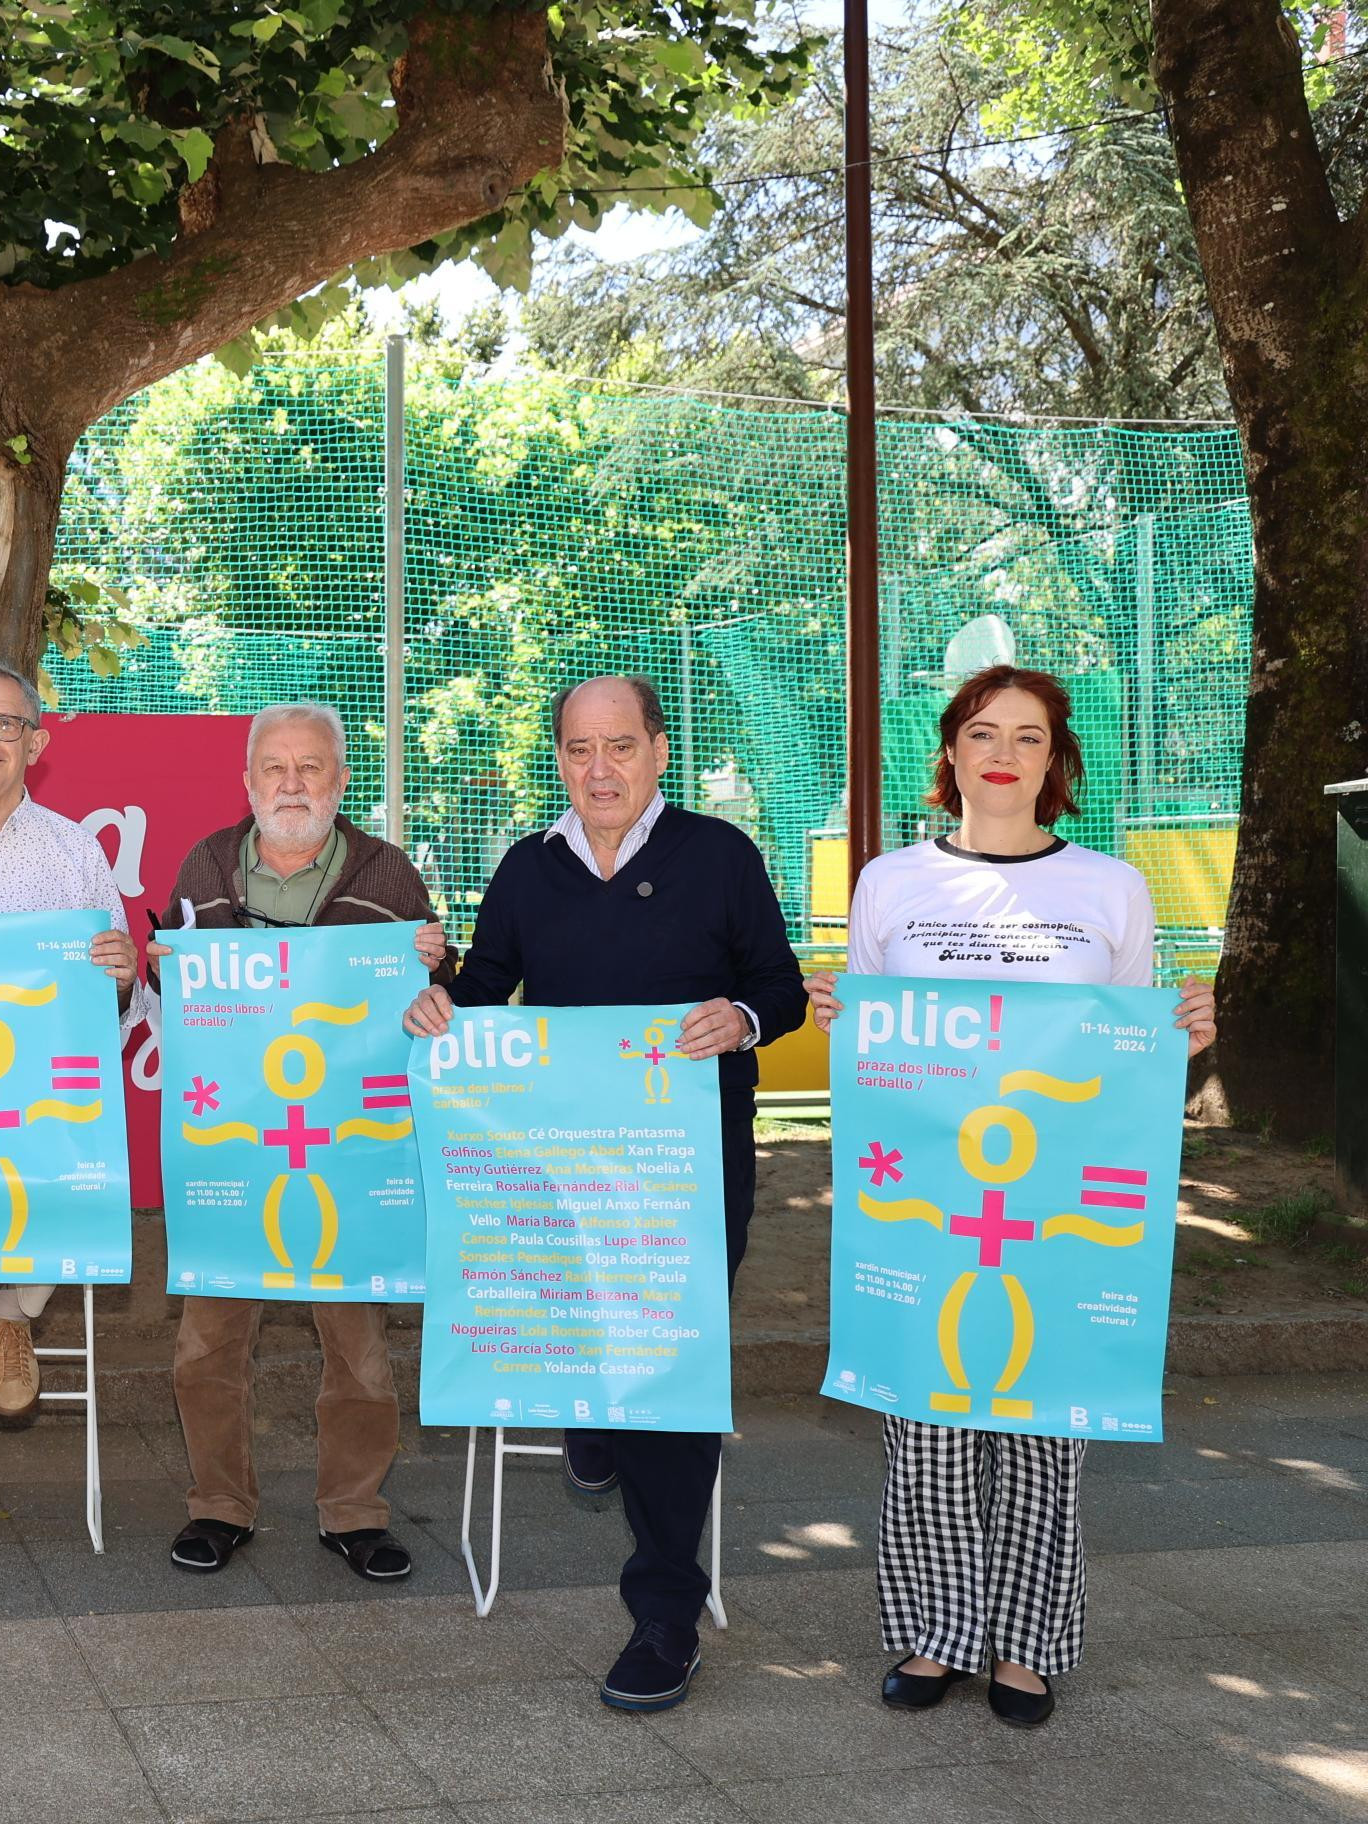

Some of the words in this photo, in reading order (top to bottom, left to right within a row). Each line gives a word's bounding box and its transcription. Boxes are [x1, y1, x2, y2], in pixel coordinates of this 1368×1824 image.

[950, 921, 978, 929] xeito
[982, 921, 996, 929] de
[1022, 921, 1085, 933] cosmopolita
[909, 930, 967, 942] principiar
[969, 931, 991, 940] por
[1055, 934, 1091, 944] mundo
[36, 941, 60, 951] 11-14
[922, 940, 943, 949] que
[969, 940, 1007, 949] diante
[63, 950, 87, 961] 2024
[348, 956, 372, 967] 11-14
[938, 949, 992, 962] Xurxo
[1000, 951, 1050, 963] Souto
[179, 941, 290, 999] plic!
[374, 967, 399, 977] 2024
[183, 1003, 212, 1014] praza
[214, 1002, 232, 1013] dos
[235, 1003, 266, 1014] libros
[183, 1016, 226, 1027] carballo
[857, 990, 1003, 1055] plic!
[1079, 1021, 1111, 1036] 11-14
[1113, 1023, 1147, 1038] xullo
[429, 1017, 550, 1080] plic!
[1113, 1039, 1146, 1052] 2024
[857, 1059, 895, 1073] praza
[898, 1061, 923, 1074] dos
[927, 1063, 967, 1078] libros
[857, 1075, 913, 1090] carballo
[528, 1127, 545, 1139] Cé
[548, 1127, 615, 1141] Orquestra
[619, 1127, 686, 1138] Pantasma
[442, 1146, 493, 1158] Golfiños
[627, 1145, 654, 1156] Xan
[657, 1144, 696, 1158] Fraga
[446, 1163, 481, 1176] Santy
[484, 1163, 542, 1175] Gutiérrez
[636, 1162, 680, 1174] Noelia
[683, 1162, 694, 1174] A
[446, 1180, 493, 1191] Ferreira
[543, 1181, 612, 1192] Fernández
[615, 1180, 640, 1191] Rial
[556, 1198, 602, 1213] Miguel
[605, 1199, 640, 1210] Anxo
[643, 1198, 691, 1210] Fernán
[469, 1214, 501, 1226] Vello
[543, 1216, 576, 1228] Barca
[510, 1232, 544, 1245] Paula
[546, 1233, 601, 1246] Cousillas
[604, 1235, 638, 1248] Lupe
[641, 1234, 687, 1246] Blanco
[585, 1252, 617, 1267] Olga
[462, 1269, 507, 1281] Ramón
[510, 1269, 562, 1282] Sánchez
[650, 1271, 687, 1283] Paula
[855, 1272, 865, 1280] de
[880, 1266, 921, 1282] municipal
[467, 1286, 537, 1300] Carballeira
[540, 1288, 582, 1300] Miriam
[586, 1289, 639, 1301] Beizana
[855, 1284, 865, 1292] de
[893, 1292, 915, 1305] 22.00
[1101, 1290, 1124, 1302] feira
[1126, 1292, 1139, 1303] da
[550, 1307, 567, 1319] De
[569, 1307, 639, 1322] Ninghures
[642, 1307, 674, 1320] Paco
[1077, 1300, 1138, 1315] creatividade
[1090, 1314, 1129, 1327] cultural
[451, 1323, 517, 1337] Nogueiras
[608, 1325, 649, 1338] Rober
[652, 1326, 700, 1341] Cagiao
[545, 1343, 575, 1355] Soto
[544, 1361, 596, 1374] Yolanda
[599, 1362, 655, 1375] Castaño
